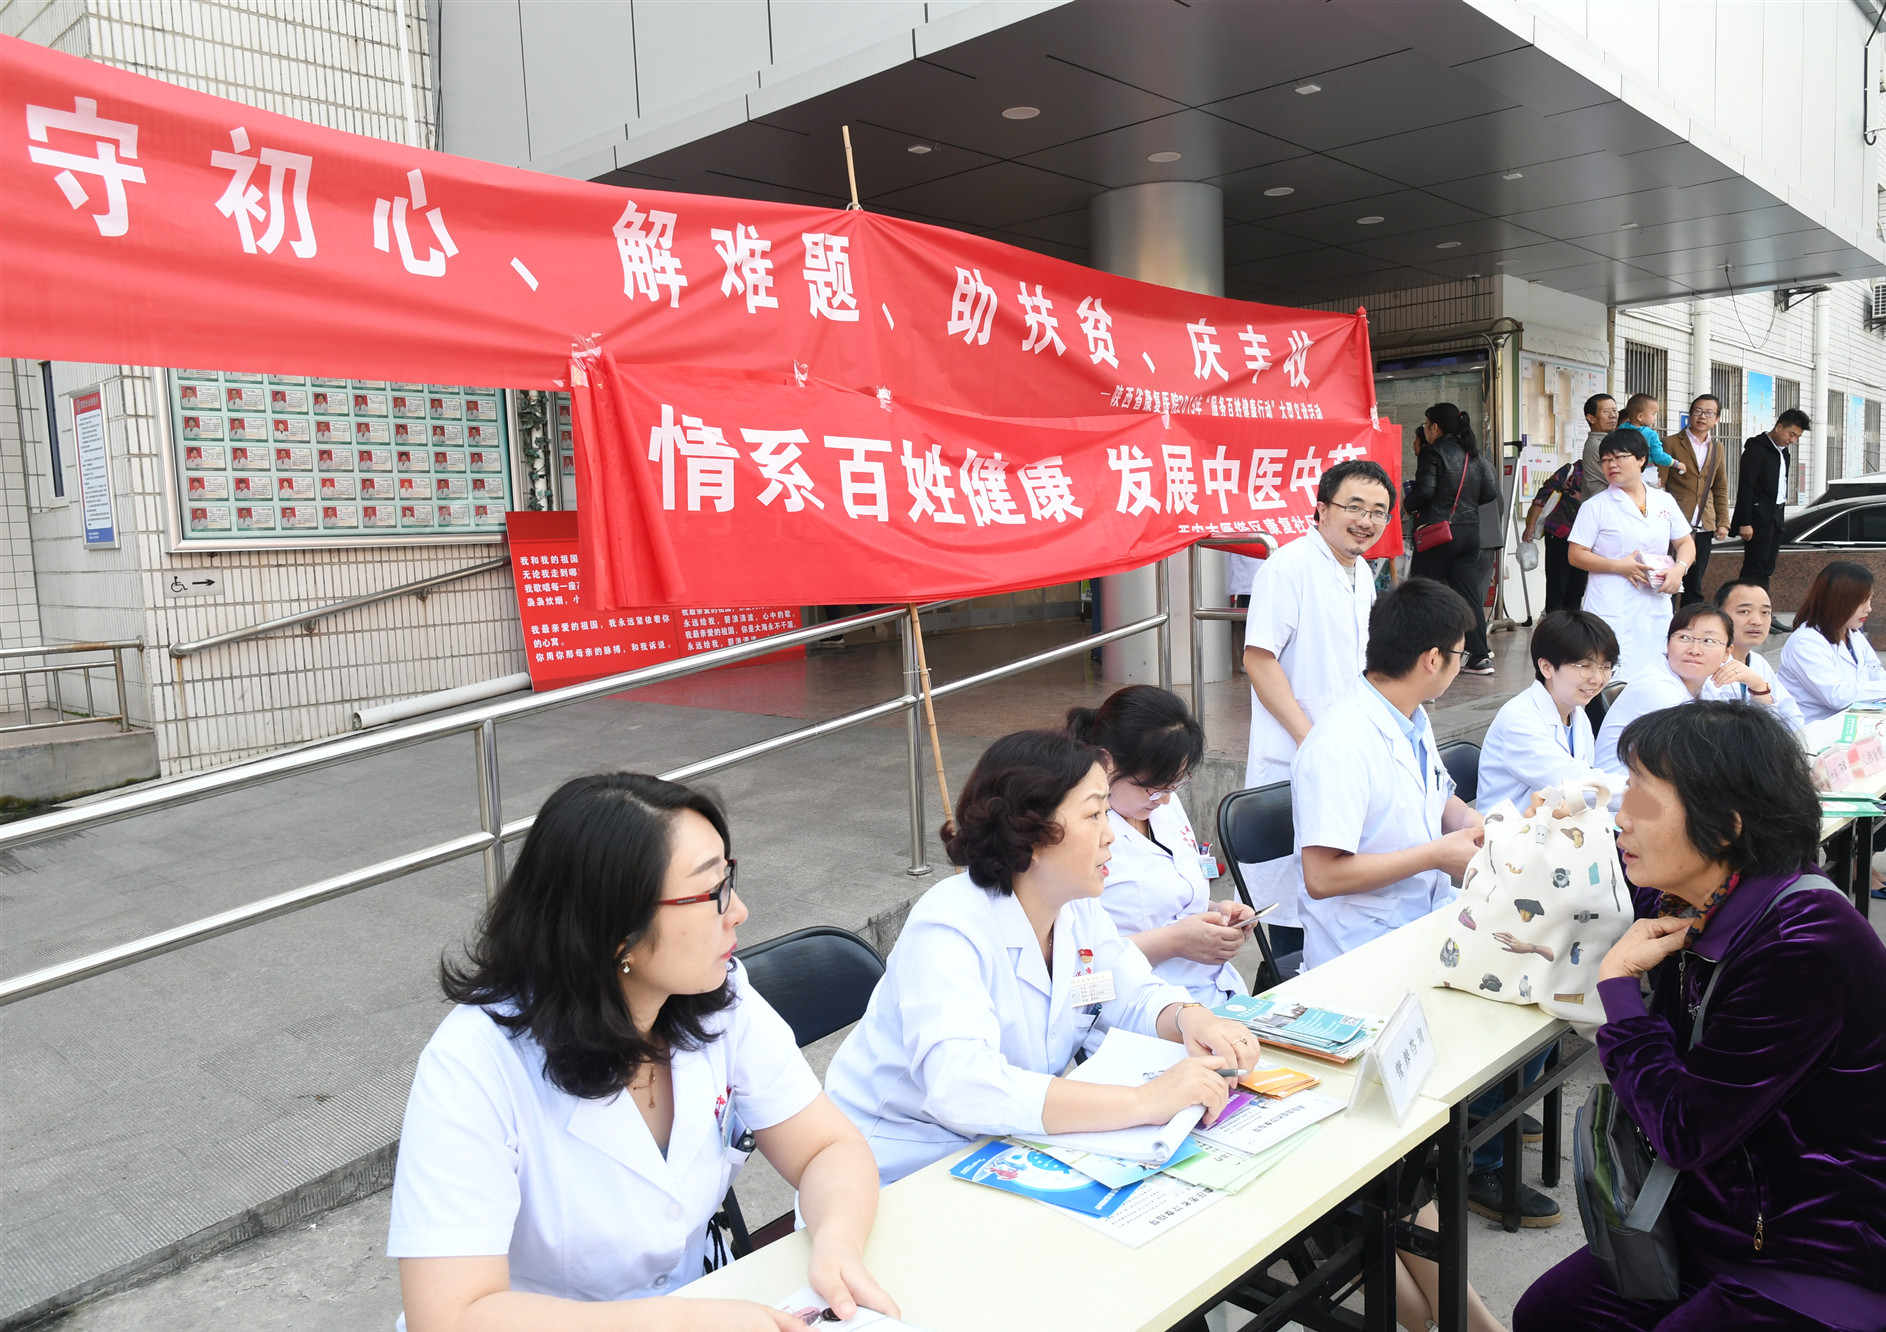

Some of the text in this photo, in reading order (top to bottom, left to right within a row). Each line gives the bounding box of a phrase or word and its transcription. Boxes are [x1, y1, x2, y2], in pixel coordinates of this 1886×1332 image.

[649, 404, 1083, 527] 情系百姓健康
[520, 554, 578, 565] 我和我的祖国
[523, 568, 580, 579] 无论我走到哪
